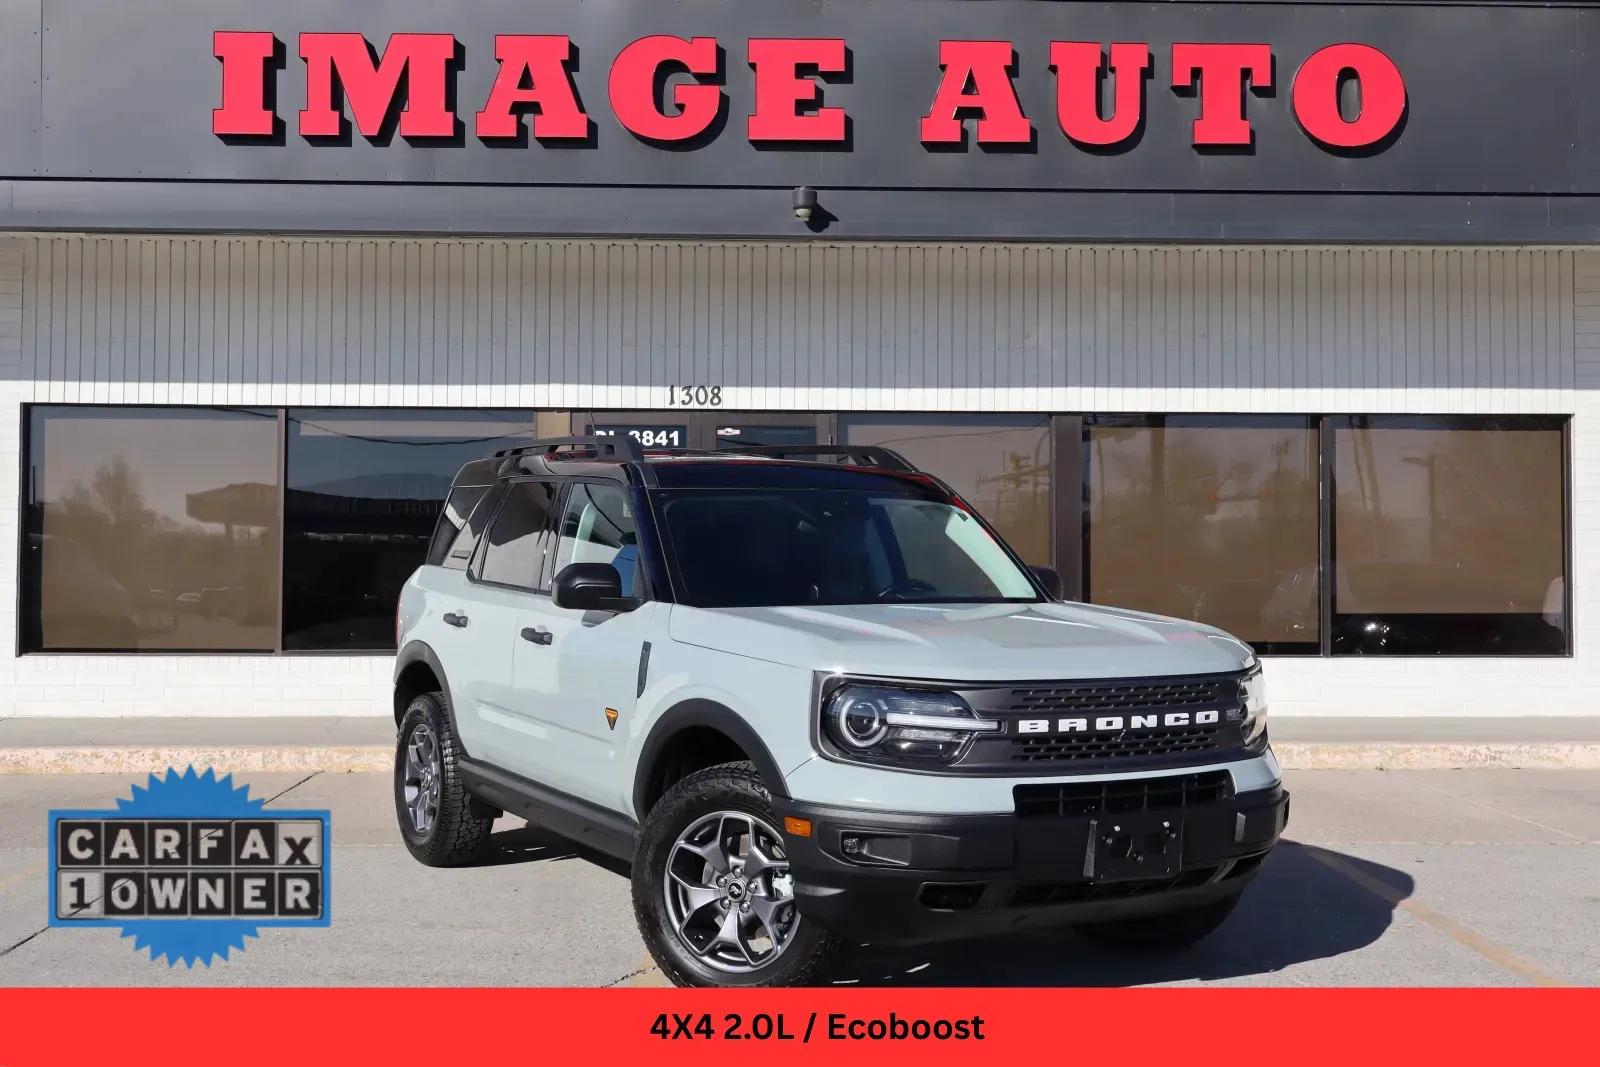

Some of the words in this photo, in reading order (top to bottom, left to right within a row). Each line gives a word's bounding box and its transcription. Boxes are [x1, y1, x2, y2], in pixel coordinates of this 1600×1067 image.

[213, 31, 846, 142] IMAGE
[920, 40, 1406, 147] AUTO
[668, 384, 722, 407] 1308
[1018, 710, 1219, 733] BRONCO
